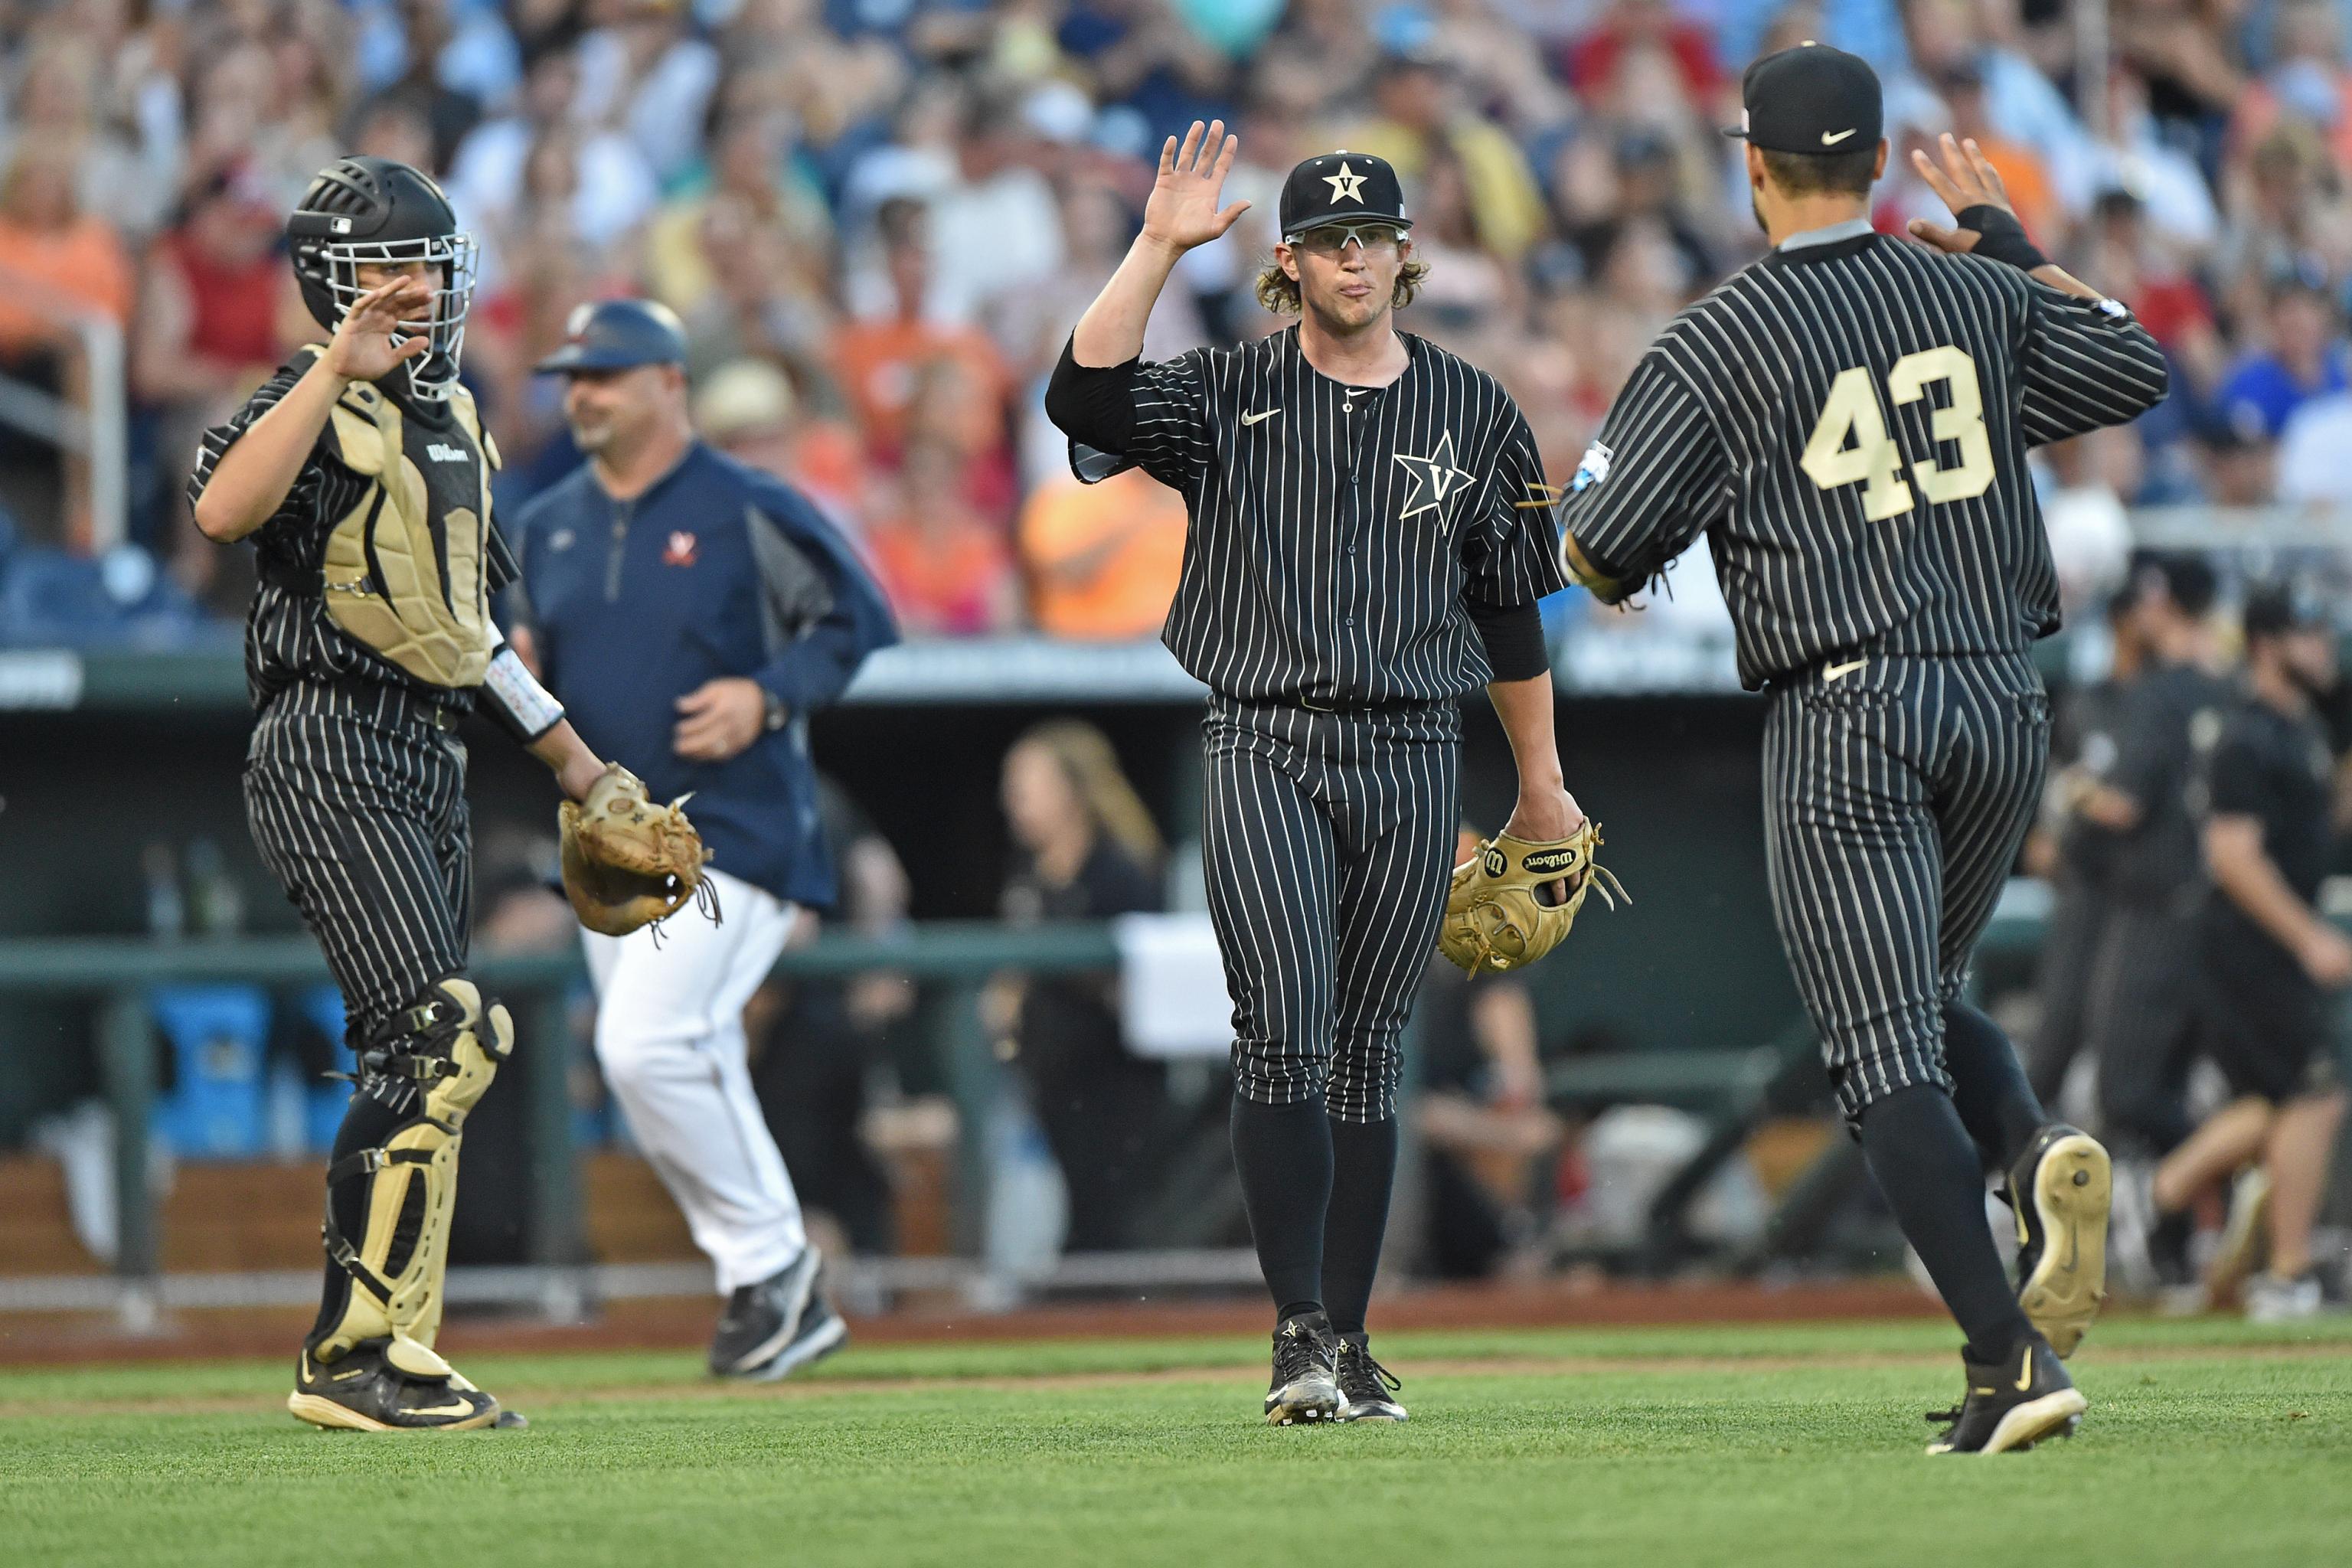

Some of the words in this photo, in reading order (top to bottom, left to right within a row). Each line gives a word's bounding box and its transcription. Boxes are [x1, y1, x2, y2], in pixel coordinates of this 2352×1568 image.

[1339, 178, 1353, 192] V
[1800, 345, 1996, 523] 43
[426, 443, 469, 462] Wilson
[1429, 464, 1455, 501] V
[1526, 851, 1573, 867] Wilson
